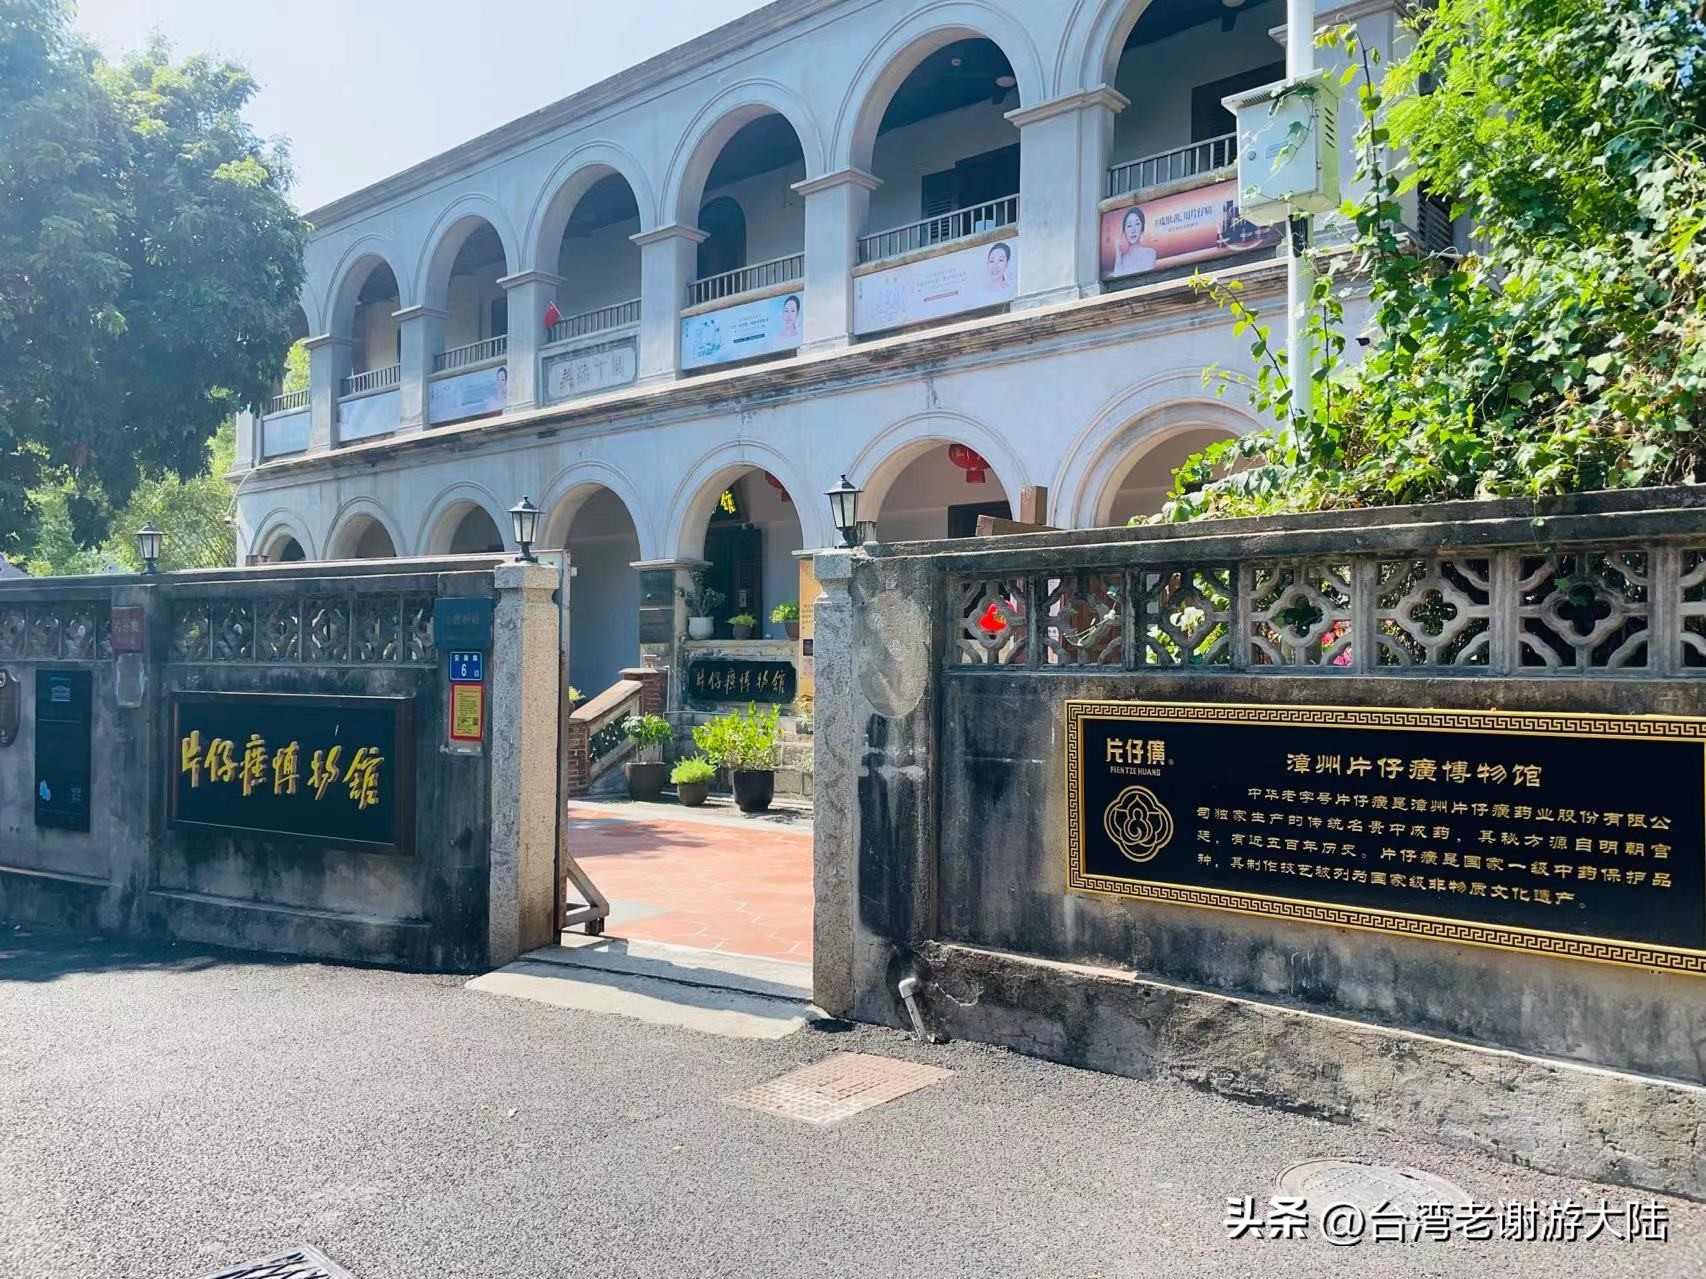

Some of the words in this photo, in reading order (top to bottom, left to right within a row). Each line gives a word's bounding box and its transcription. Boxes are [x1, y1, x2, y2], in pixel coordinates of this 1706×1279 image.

[461, 664, 467, 677] 6
[1105, 737, 1165, 765] 片仔癀
[1286, 753, 1543, 787] 漳州片仔癀博物馆
